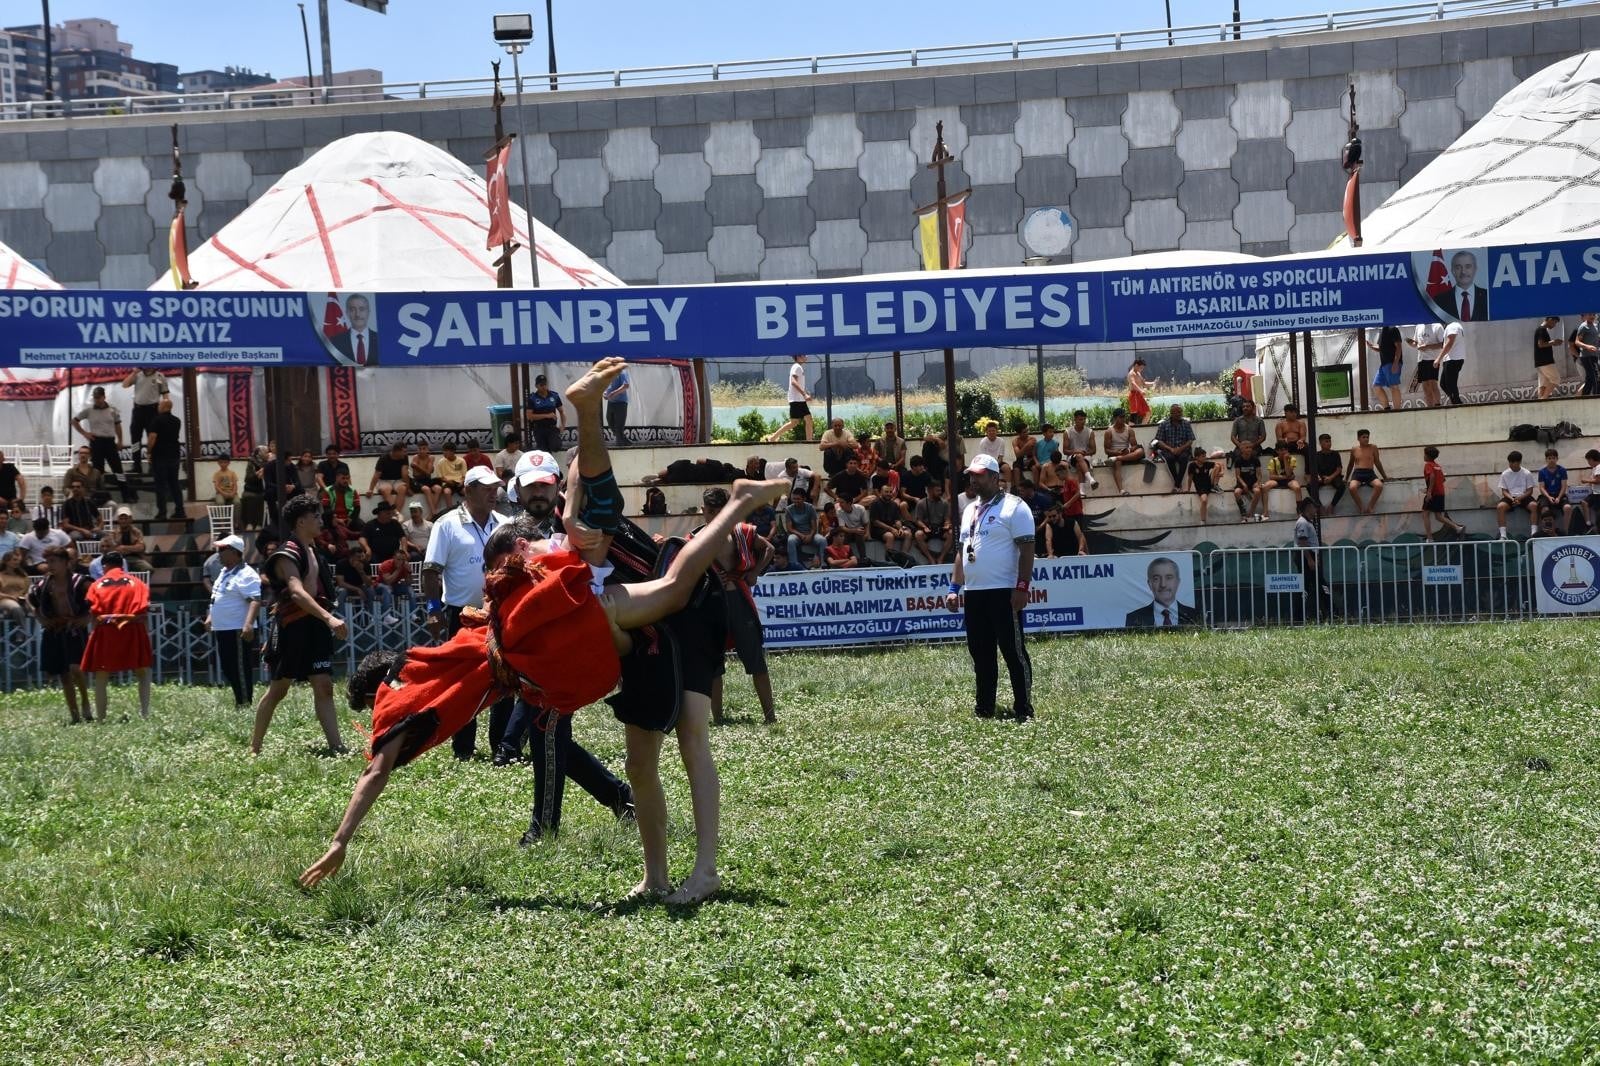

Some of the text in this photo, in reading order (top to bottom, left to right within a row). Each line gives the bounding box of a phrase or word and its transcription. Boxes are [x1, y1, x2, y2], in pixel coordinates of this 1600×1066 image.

[1110, 262, 1408, 297] TÜM ANTRENÖR ve SPORCULARIMIZA
[1492, 249, 1571, 288] ATA
[0, 296, 304, 318] SPORUN ve SPORCUNUN
[1175, 288, 1342, 317] BAŞARILAR DİLERİM
[77, 322, 232, 344] YANINDAYIZ
[1136, 324, 1174, 335] Mehmet
[1176, 320, 1243, 332] TAHMAZOĞLU
[1252, 317, 1296, 329] Şahinbey
[1298, 313, 1340, 325] Belediye
[1341, 312, 1379, 323] Başkanı
[24, 351, 66, 360] Mehmet
[69, 350, 141, 361] TAHMAZOĞLU
[150, 351, 196, 361] Şahinbey
[197, 350, 239, 361] Belediye
[241, 350, 279, 360] Başkanı
[778, 581, 809, 597] ABA
[811, 576, 863, 595] GÜREŞİ
[865, 572, 928, 592] TÜRKİYE
[1052, 563, 1115, 580] KATILAN
[766, 598, 903, 619] PEHLİVANLARIMIZA
[763, 627, 798, 638] hmet
[801, 620, 892, 637] TAHMAZOĞLU
[904, 617, 964, 631] Şahinbey
[1025, 611, 1077, 624] Başkanı
